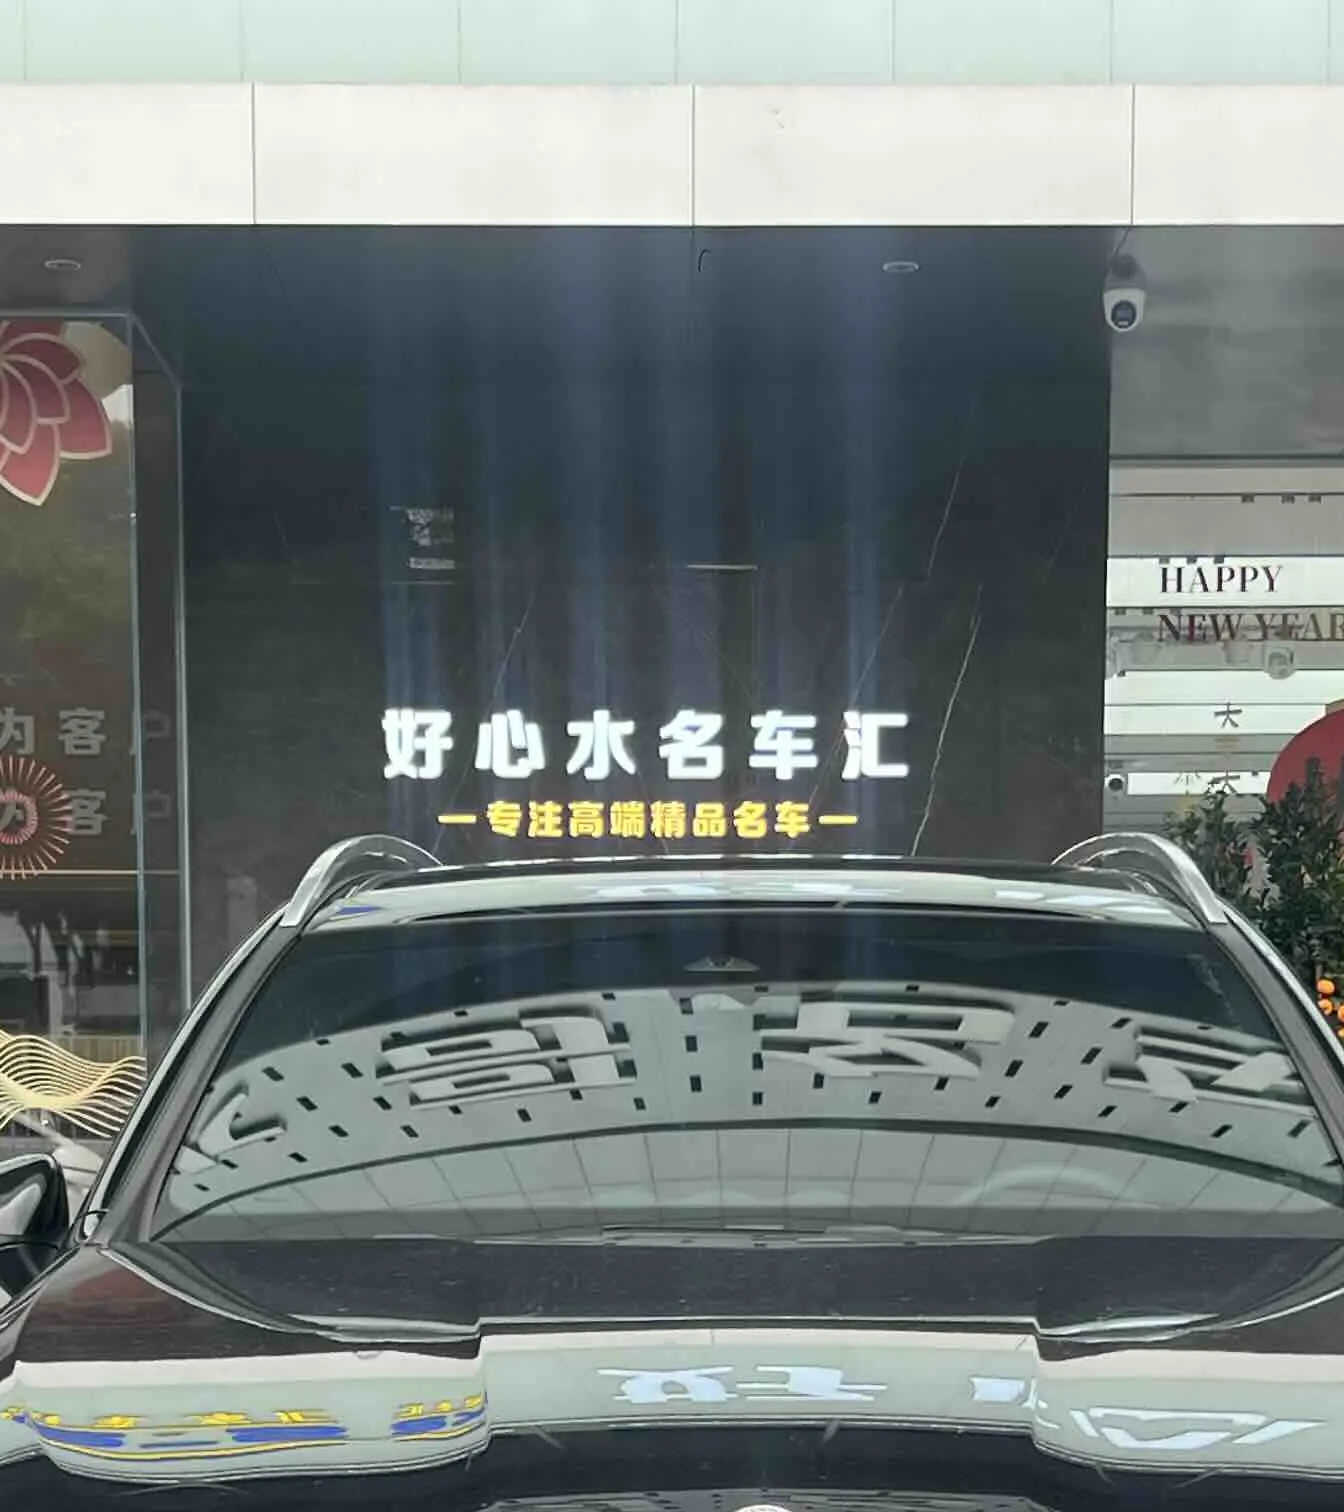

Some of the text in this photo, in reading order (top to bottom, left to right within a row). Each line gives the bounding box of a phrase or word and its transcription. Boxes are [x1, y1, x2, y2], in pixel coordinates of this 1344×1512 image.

[1159, 564, 1284, 594] HAPPY
[1158, 613, 1244, 642] NEW
[381, 708, 910, 780] 好心水名车汇
